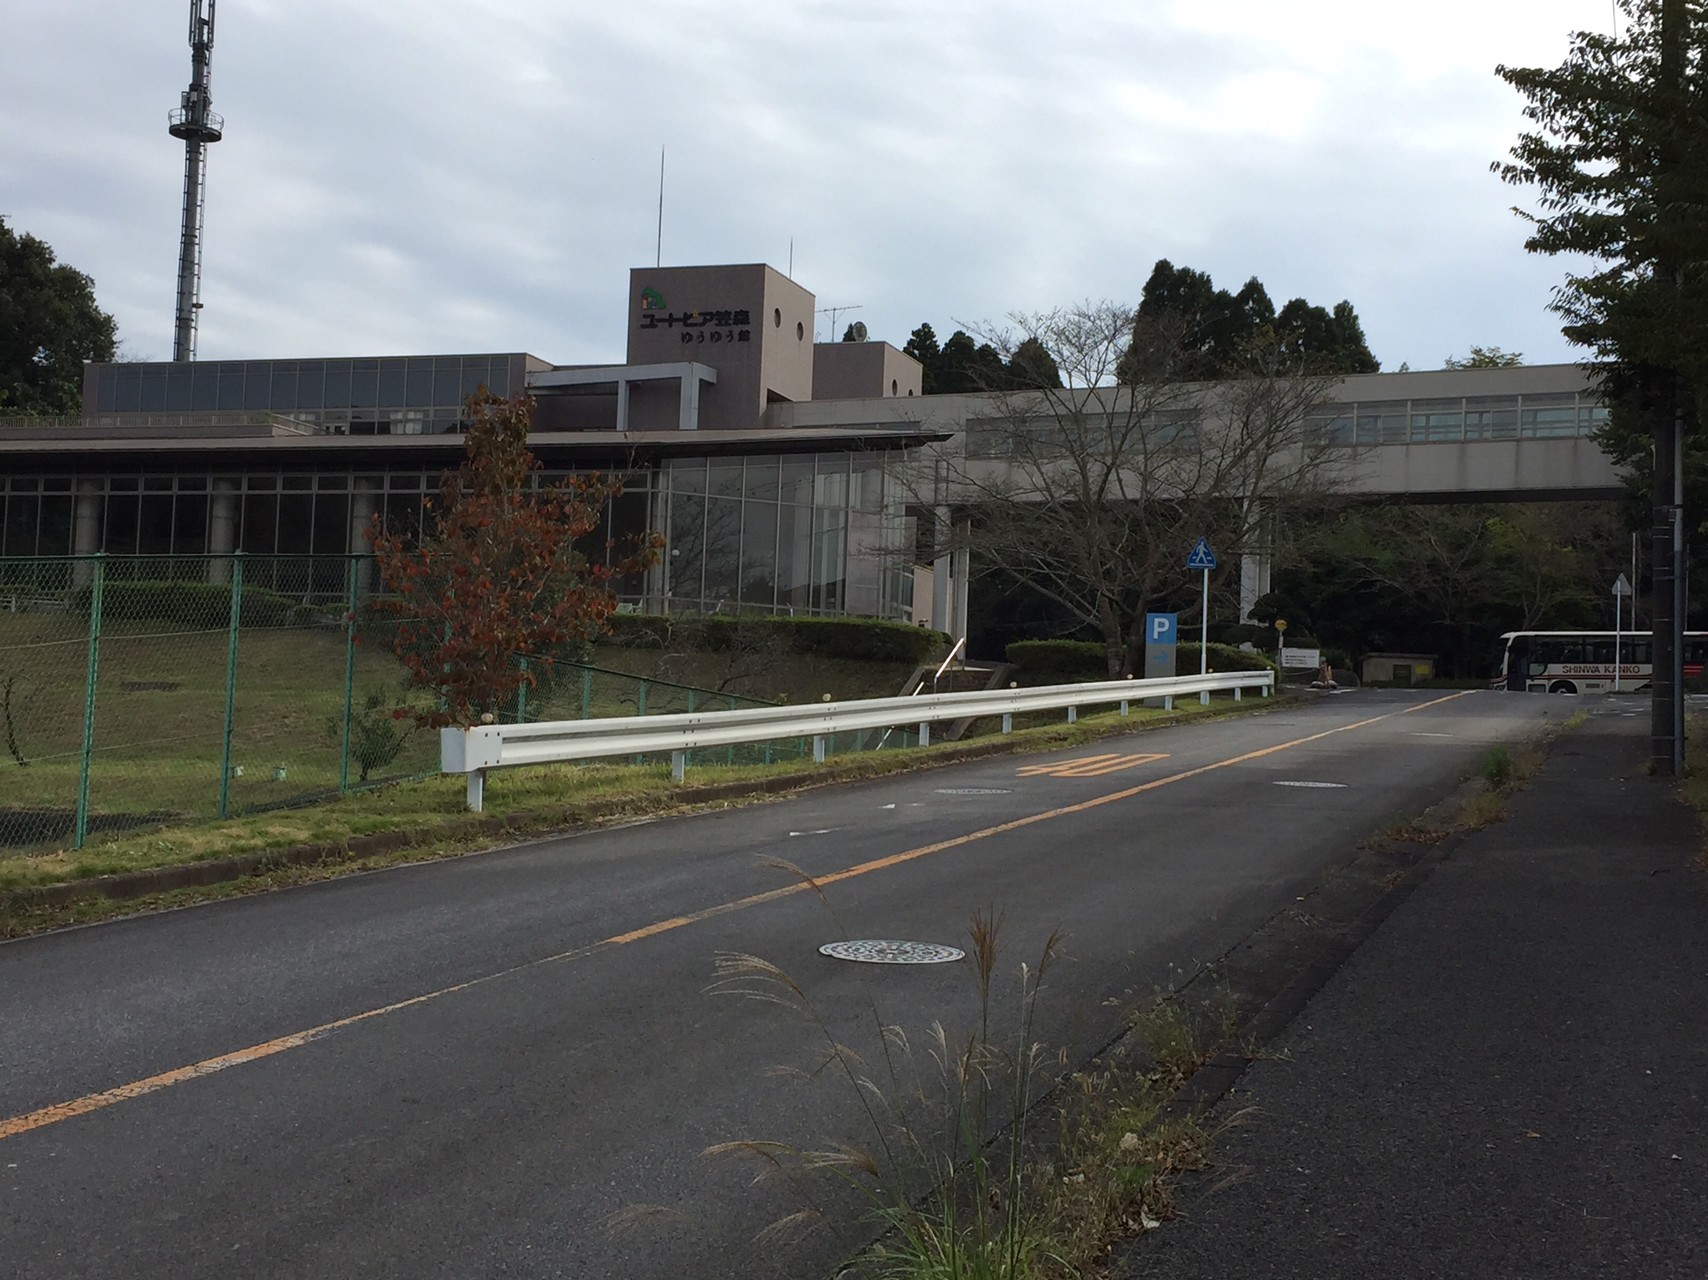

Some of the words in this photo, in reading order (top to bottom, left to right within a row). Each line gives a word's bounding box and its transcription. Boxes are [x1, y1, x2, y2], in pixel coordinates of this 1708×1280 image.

[681, 329, 751, 344] ゆうゆう館
[1153, 617, 1170, 640] P
[1562, 665, 1601, 674] SHINWA
[1604, 665, 1641, 674] KANKO
[1015, 753, 1171, 777] 40
